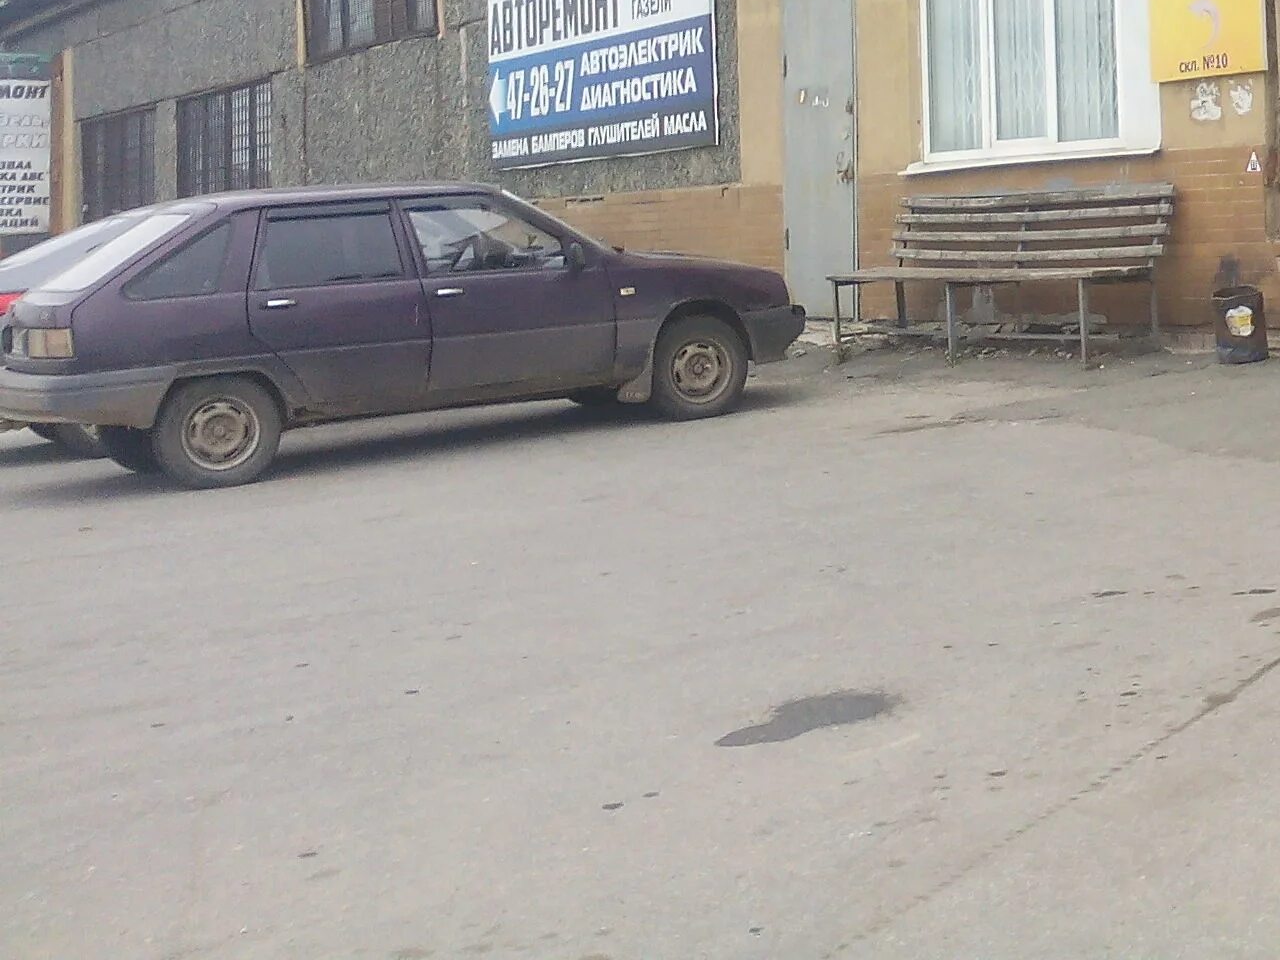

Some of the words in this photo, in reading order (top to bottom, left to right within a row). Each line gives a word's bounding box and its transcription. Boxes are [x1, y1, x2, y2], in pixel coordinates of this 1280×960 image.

[580, 28, 704, 76] АВТОЭЛЕКТРИК
[1202, 52, 1228, 70] №10
[580, 67, 697, 111] ДИАГНОСТИКА
[492, 138, 529, 159] ЗАМЕНА
[531, 128, 584, 154] БАМПЕРОВ
[588, 113, 660, 146] ГЛУШИТЕЛЕЙ
[664, 110, 707, 136] МАСЛА
